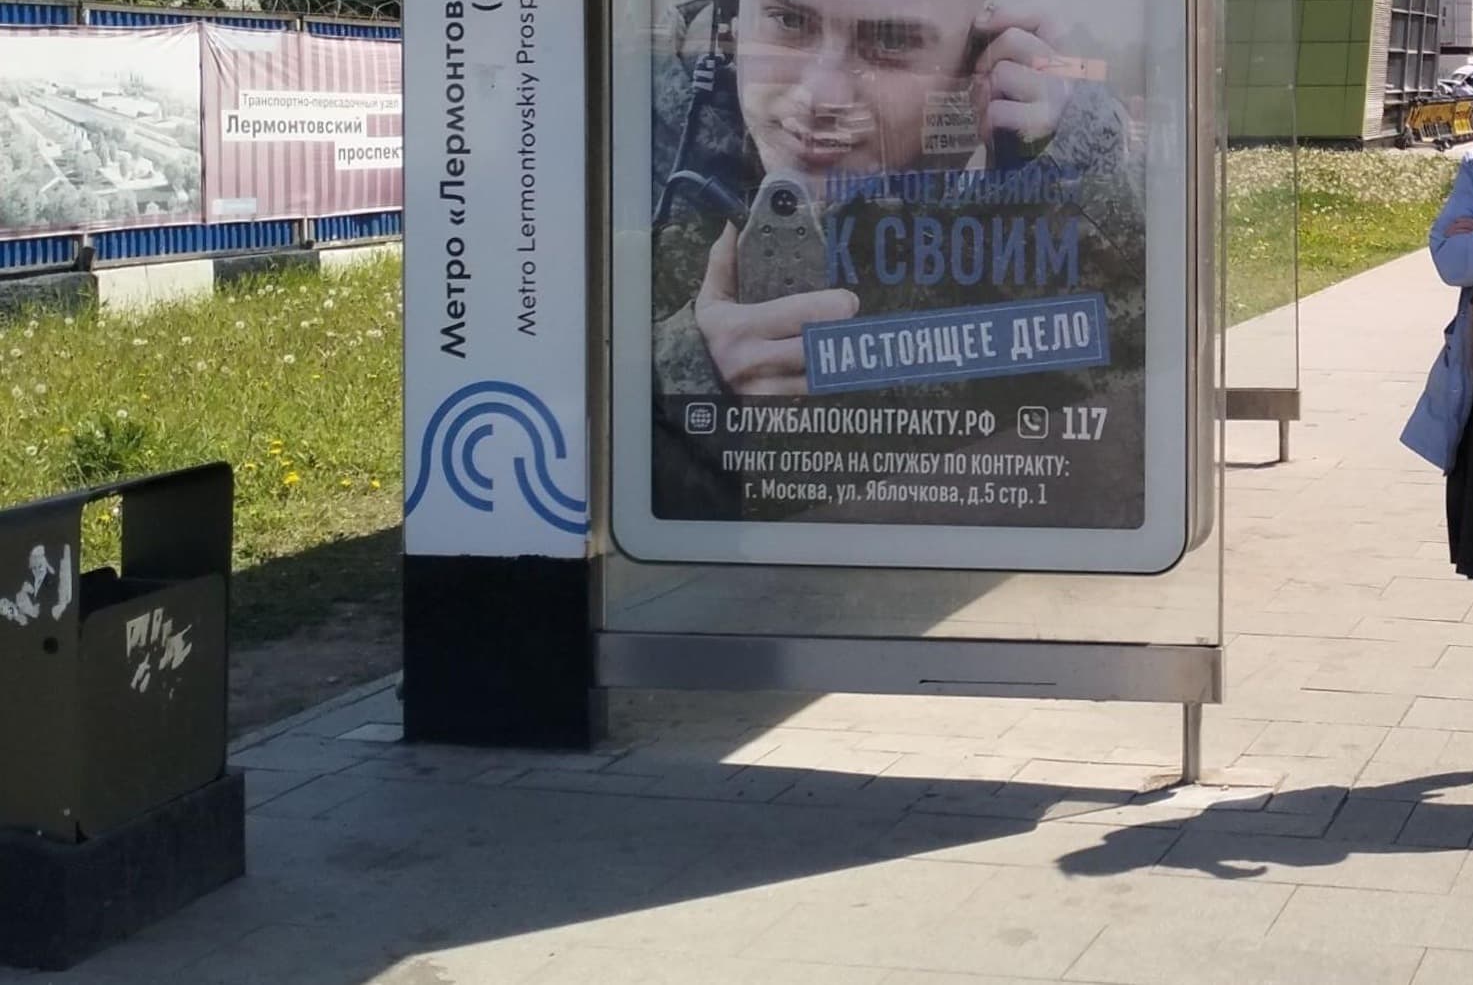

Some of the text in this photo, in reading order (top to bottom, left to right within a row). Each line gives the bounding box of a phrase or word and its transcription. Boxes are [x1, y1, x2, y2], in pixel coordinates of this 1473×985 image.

[226, 114, 362, 138] Лермонтовский
[338, 145, 402, 165] проспек
[515, 72, 540, 252] Lermontovskiy
[826, 216, 1080, 286] К СВОИМ
[440, 237, 472, 359] Метро
[516, 261, 537, 336] Metro
[818, 311, 1090, 374] НАСТОЯЩЕЕ ДЕЛО
[726, 406, 996, 436] СЛУЖБАПОКОНТРАКТУ.РФ
[1062, 407, 1107, 440] 117
[723, 450, 1070, 477] ПУНКТ ОТБОРА НА СЛУЖБУ ПО КОНТРАКТУ:
[745, 479, 1048, 509] г. Москва, ул. Яблочкова, д.5 стр. 1
